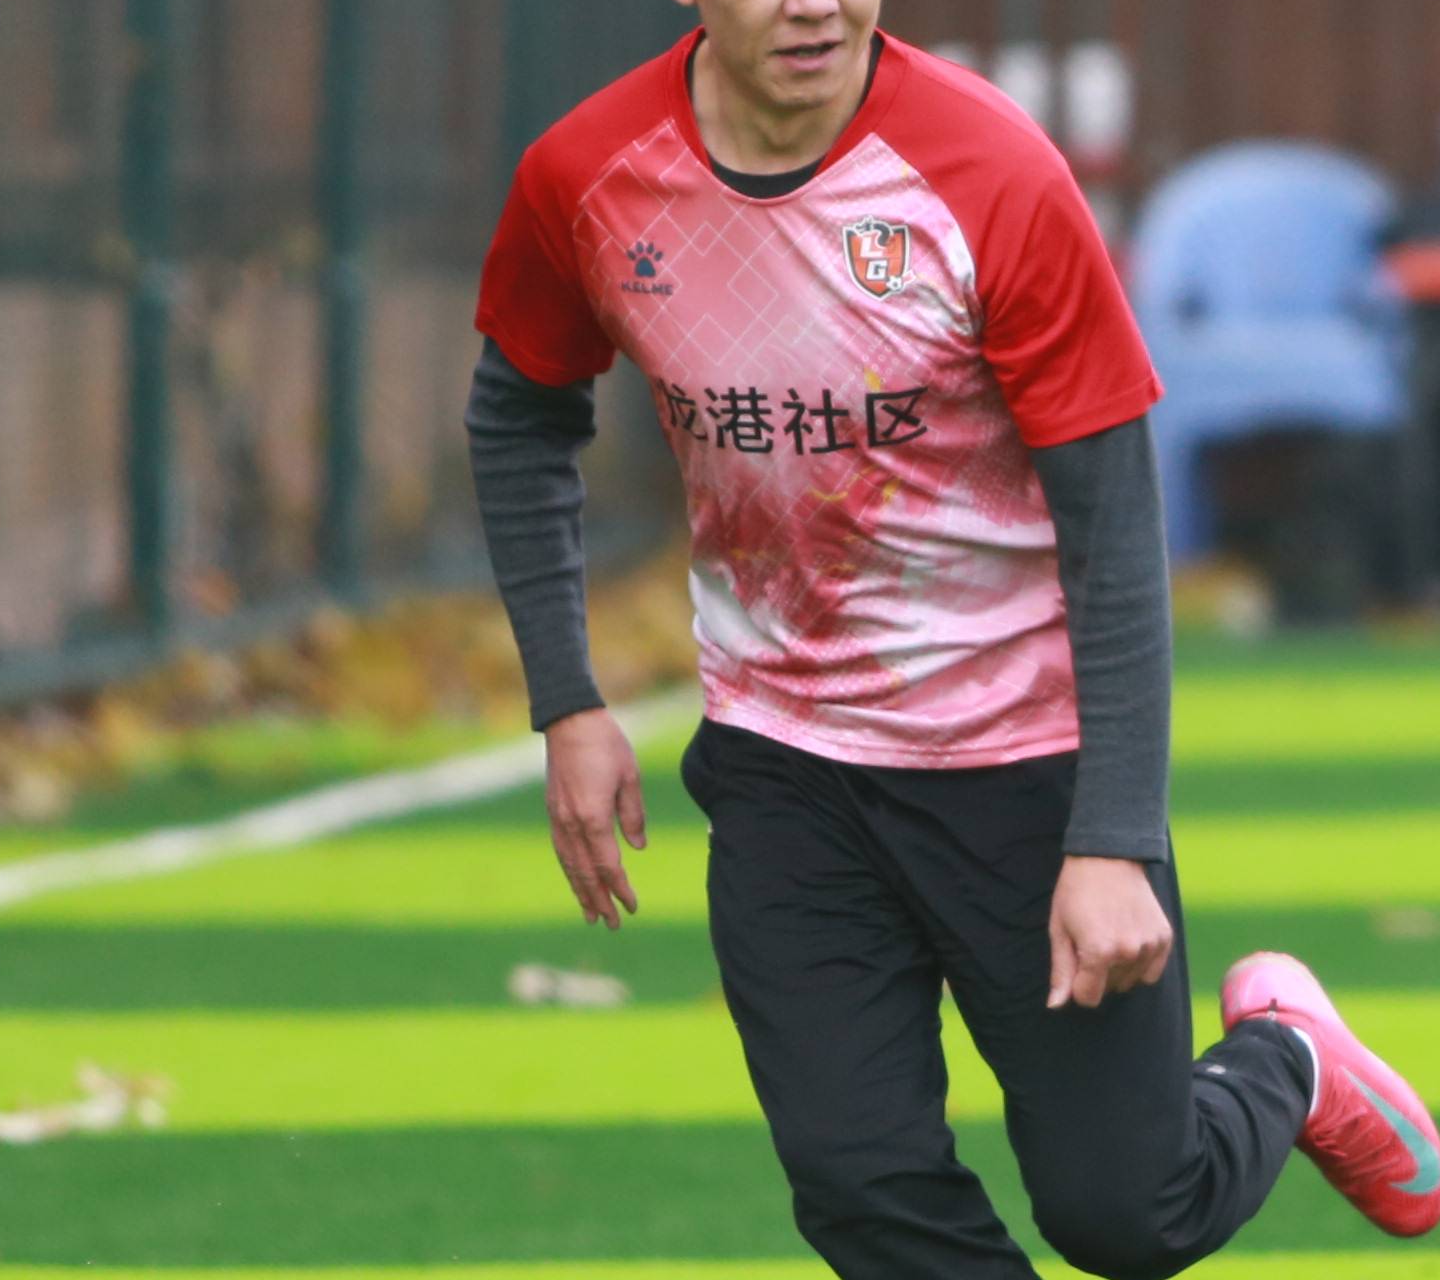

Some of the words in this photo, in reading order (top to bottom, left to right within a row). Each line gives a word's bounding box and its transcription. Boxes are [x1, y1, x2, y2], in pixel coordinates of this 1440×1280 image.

[621, 281, 673, 296] KELME
[656, 375, 928, 455] 龙港社区
